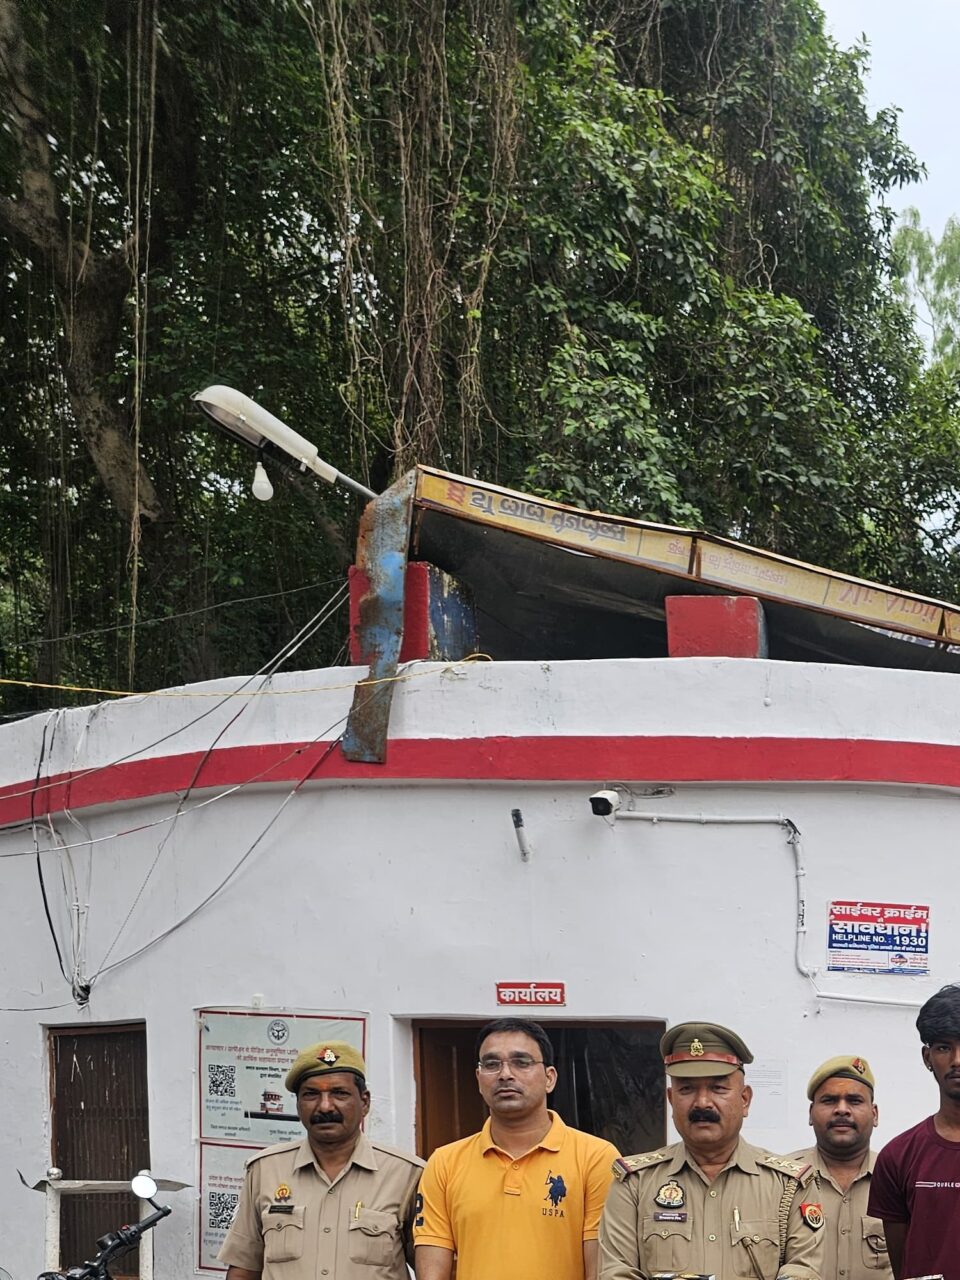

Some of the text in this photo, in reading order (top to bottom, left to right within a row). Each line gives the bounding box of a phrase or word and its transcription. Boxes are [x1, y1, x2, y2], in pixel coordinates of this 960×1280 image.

[832, 934, 871, 942] HELPLINE
[894, 936, 926, 946] 1930
[498, 983, 562, 1002] कार्यालय
[542, 1207, 565, 1218] USPA
